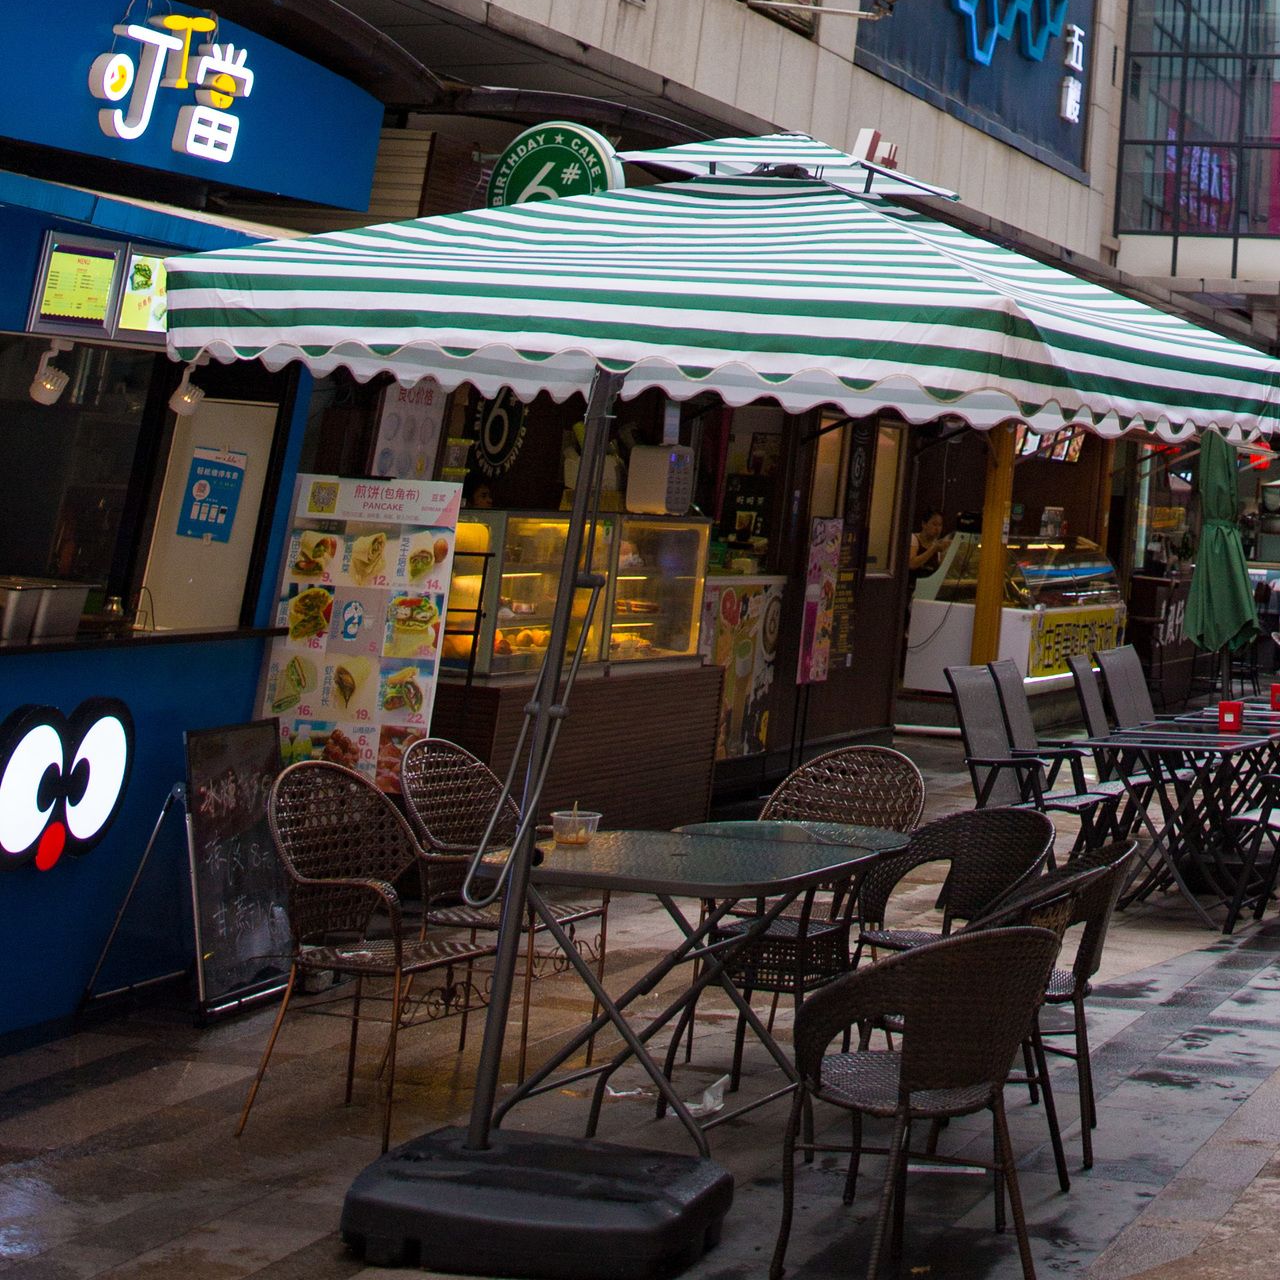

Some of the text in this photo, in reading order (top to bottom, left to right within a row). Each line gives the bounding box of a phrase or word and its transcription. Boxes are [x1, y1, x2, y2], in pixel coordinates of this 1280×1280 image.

[492, 133, 602, 207] BIRTHDAY CAKE
[362, 502, 405, 512] PANCAKE
